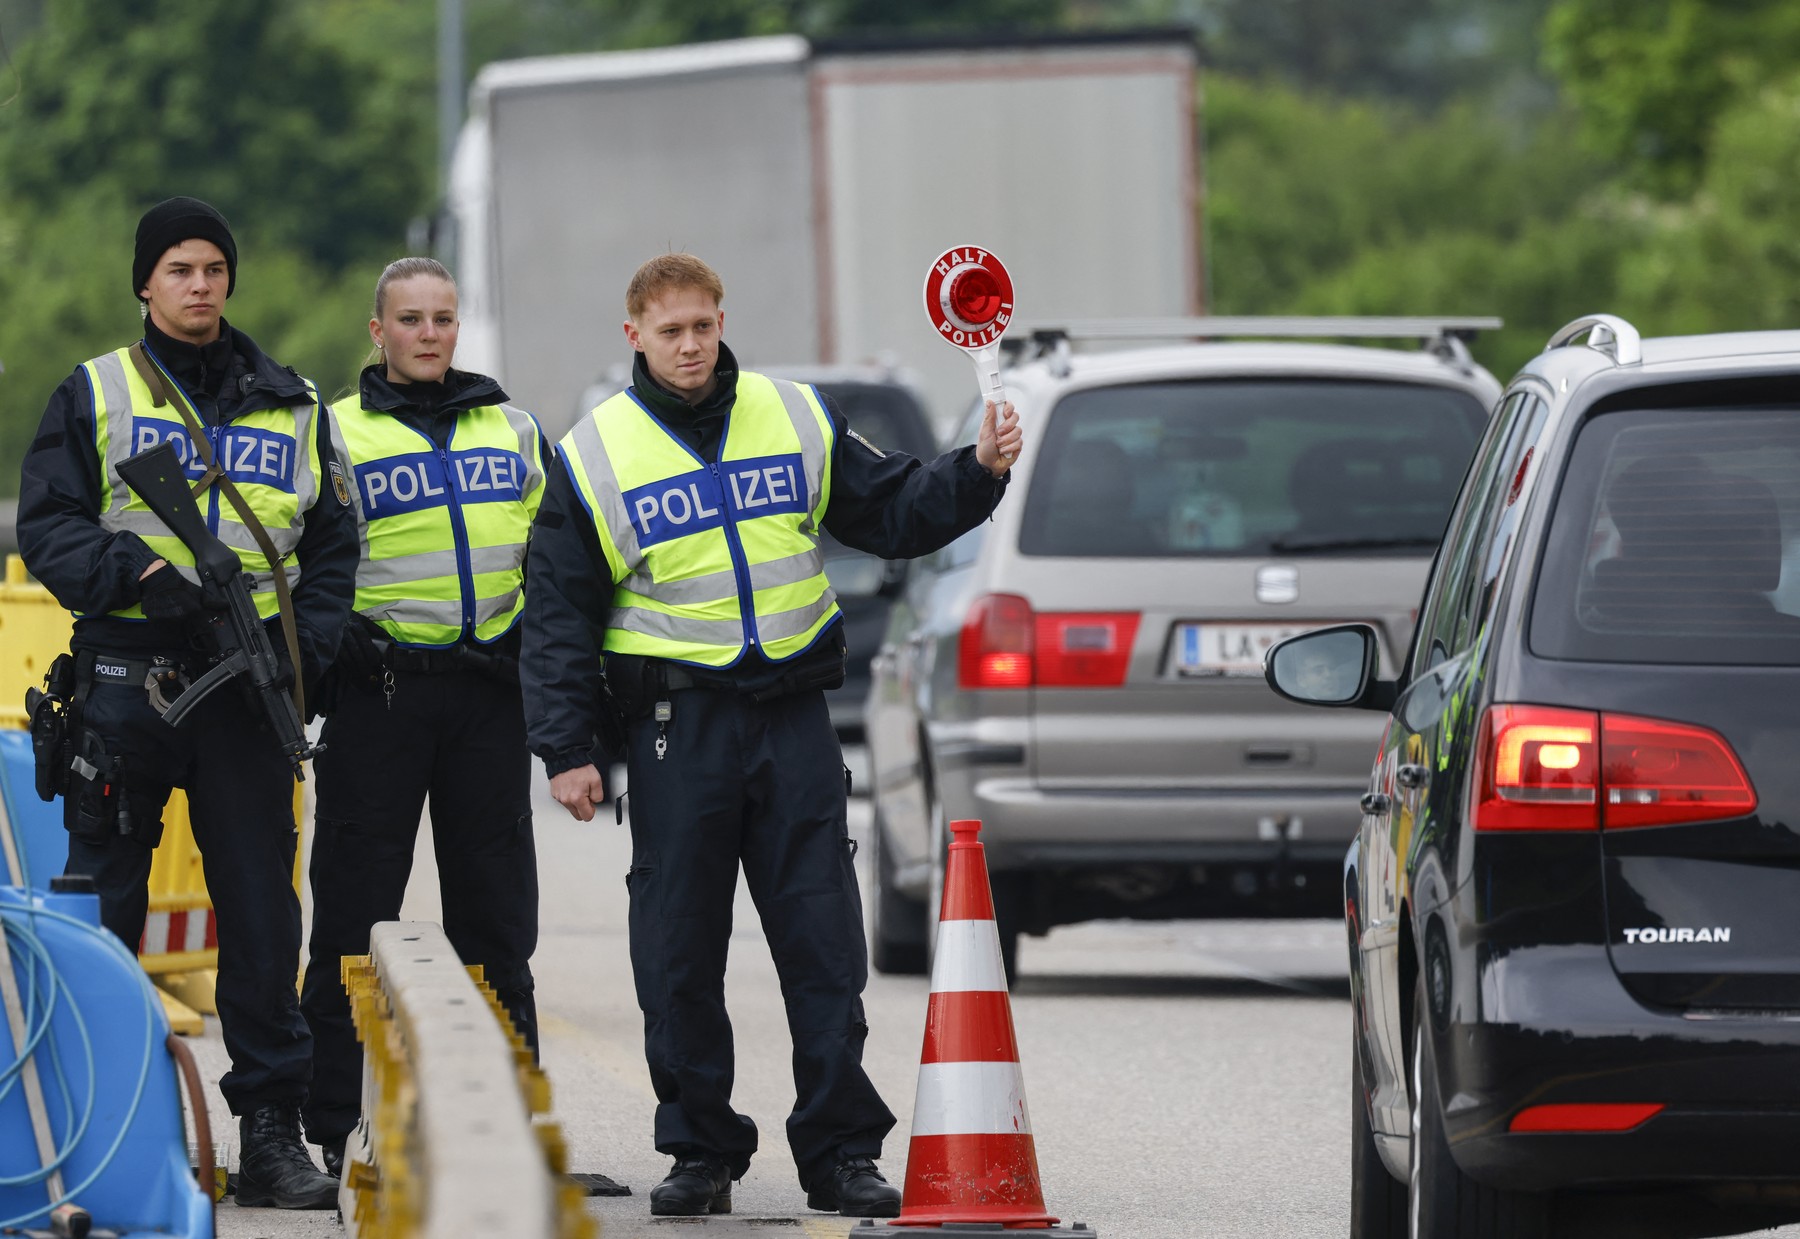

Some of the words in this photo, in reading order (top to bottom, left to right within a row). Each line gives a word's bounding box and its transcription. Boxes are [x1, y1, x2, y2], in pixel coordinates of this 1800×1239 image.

[935, 248, 988, 277] HALT
[939, 302, 1012, 347] POLIZEI
[364, 455, 521, 510] POLIZEI
[635, 464, 799, 535] POLIZEI
[95, 663, 127, 677] POLIZEI
[1622, 926, 1731, 944] TOURAN
